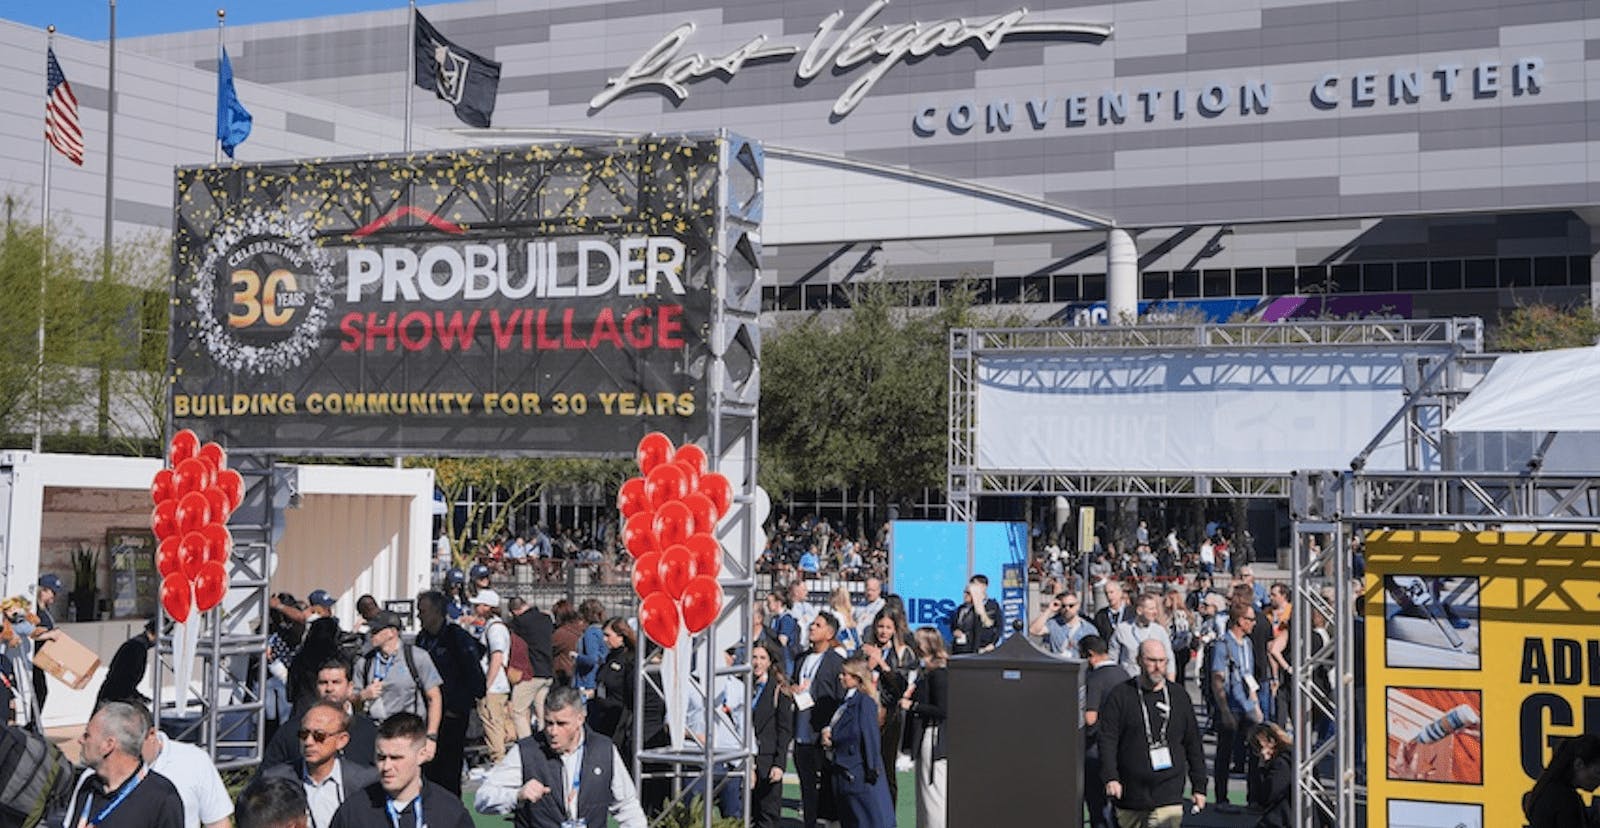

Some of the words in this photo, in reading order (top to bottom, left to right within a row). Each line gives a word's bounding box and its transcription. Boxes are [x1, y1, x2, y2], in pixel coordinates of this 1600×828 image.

[590, 21, 800, 108] Las
[797, 0, 1112, 116] Vegas
[912, 77, 1274, 137] CONVENTION
[1310, 55, 1548, 111] CENTER
[228, 240, 303, 268] CELEBRATING
[346, 235, 686, 302] PROBUILDER
[227, 268, 298, 329] 30
[276, 291, 306, 308] YEARS
[340, 309, 482, 352] SHOW
[490, 304, 685, 350] VILLAGE
[174, 392, 296, 418] BUILDING
[305, 392, 471, 416] COMMUNITY
[483, 392, 541, 416] FOR
[553, 391, 587, 416] 30
[602, 391, 696, 416] YEARS
[908, 598, 957, 625] IBS
